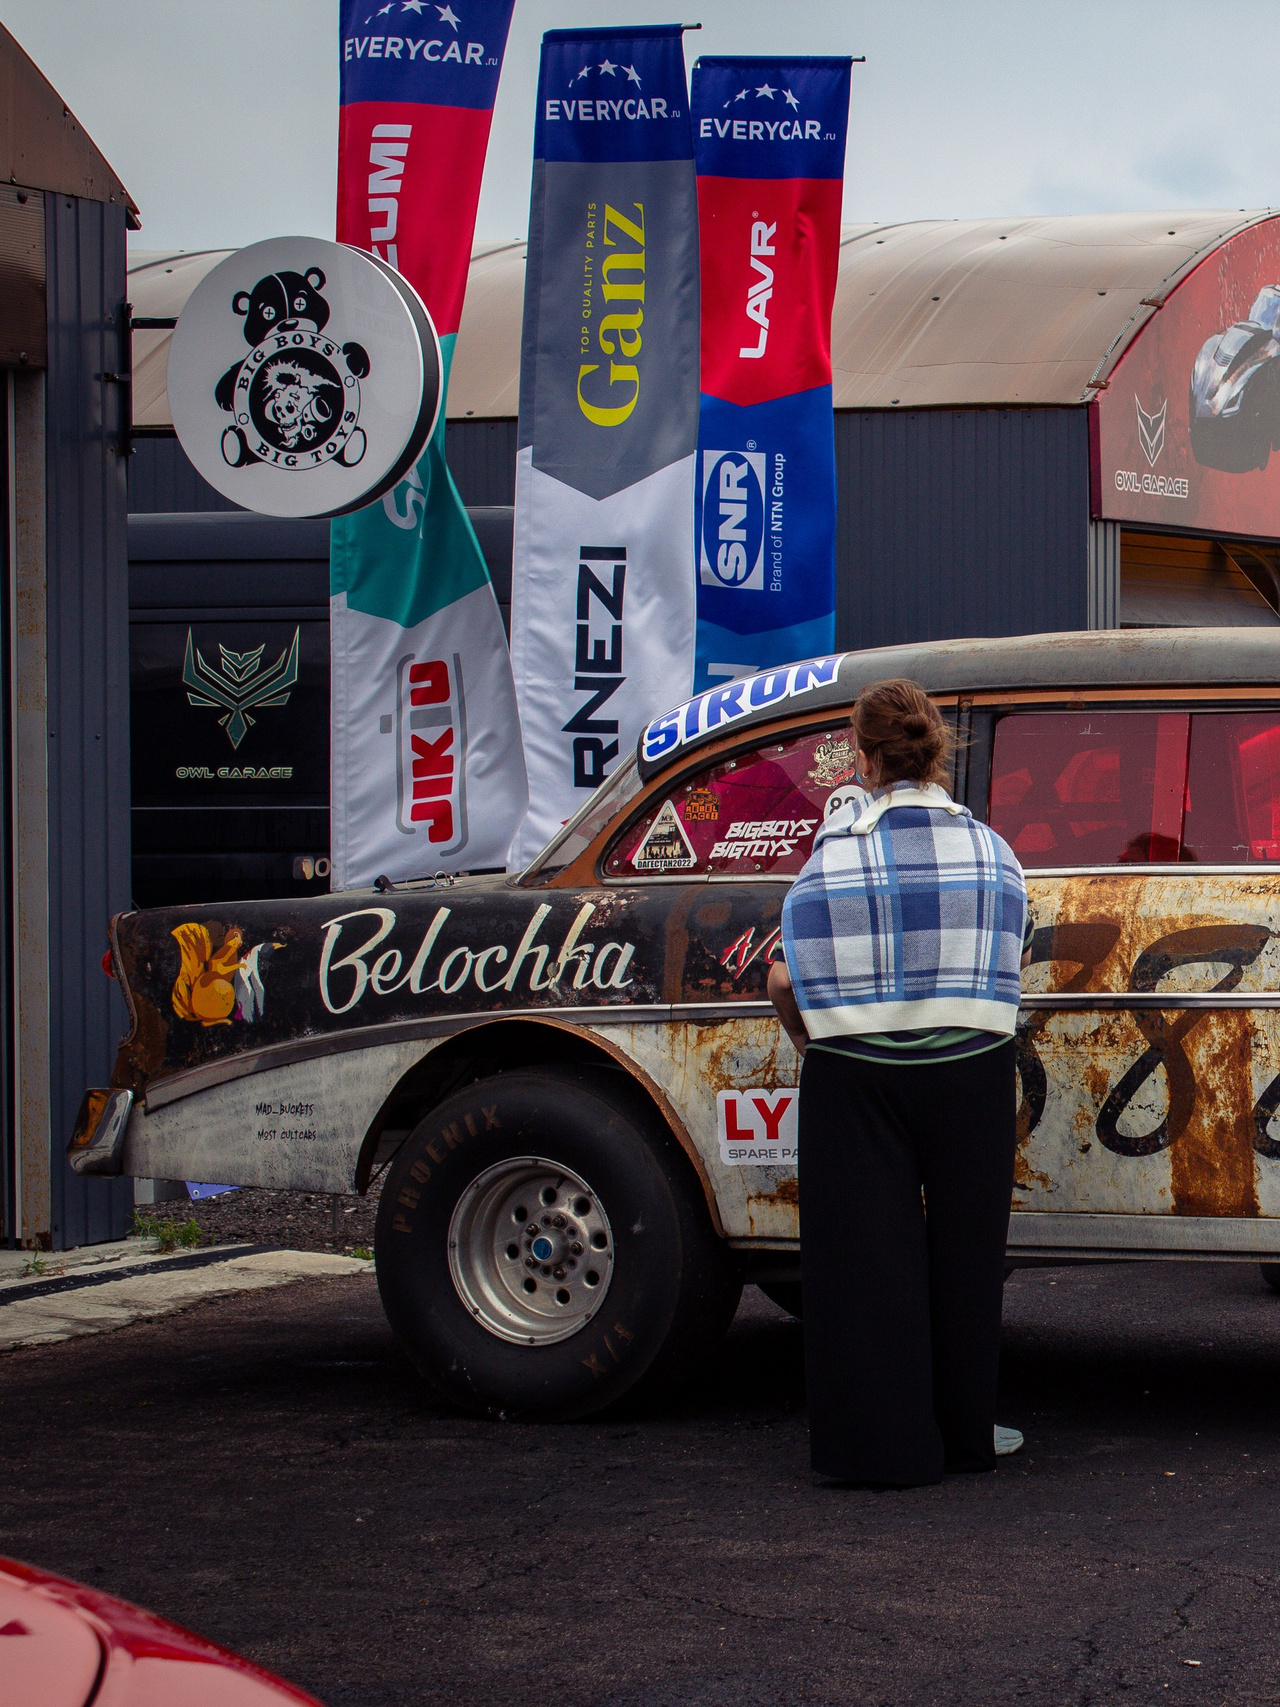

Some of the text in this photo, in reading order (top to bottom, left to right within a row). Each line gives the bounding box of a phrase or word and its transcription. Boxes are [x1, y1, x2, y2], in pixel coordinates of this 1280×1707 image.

[580, 202, 597, 354] TOP QUALITY PARTS
[739, 221, 777, 359] LAVR
[577, 202, 646, 427] Ganz
[238, 349, 266, 391] BIG
[255, 410, 356, 466] BIG TOYS
[1115, 470, 1189, 498] OWL GARAGE
[717, 460, 749, 581] SNR
[770, 453, 787, 592] Brand of NTN Group
[643, 654, 848, 762] SIRON
[176, 766, 293, 779] OWL GARAGE
[685, 812, 719, 820] RACE!
[725, 818, 818, 840] BIGBOYS
[708, 839, 798, 859] BIGTOYS
[320, 902, 635, 1014] Belochka
[257, 1128, 277, 1141] MOST
[728, 1148, 778, 1160] SPARE
